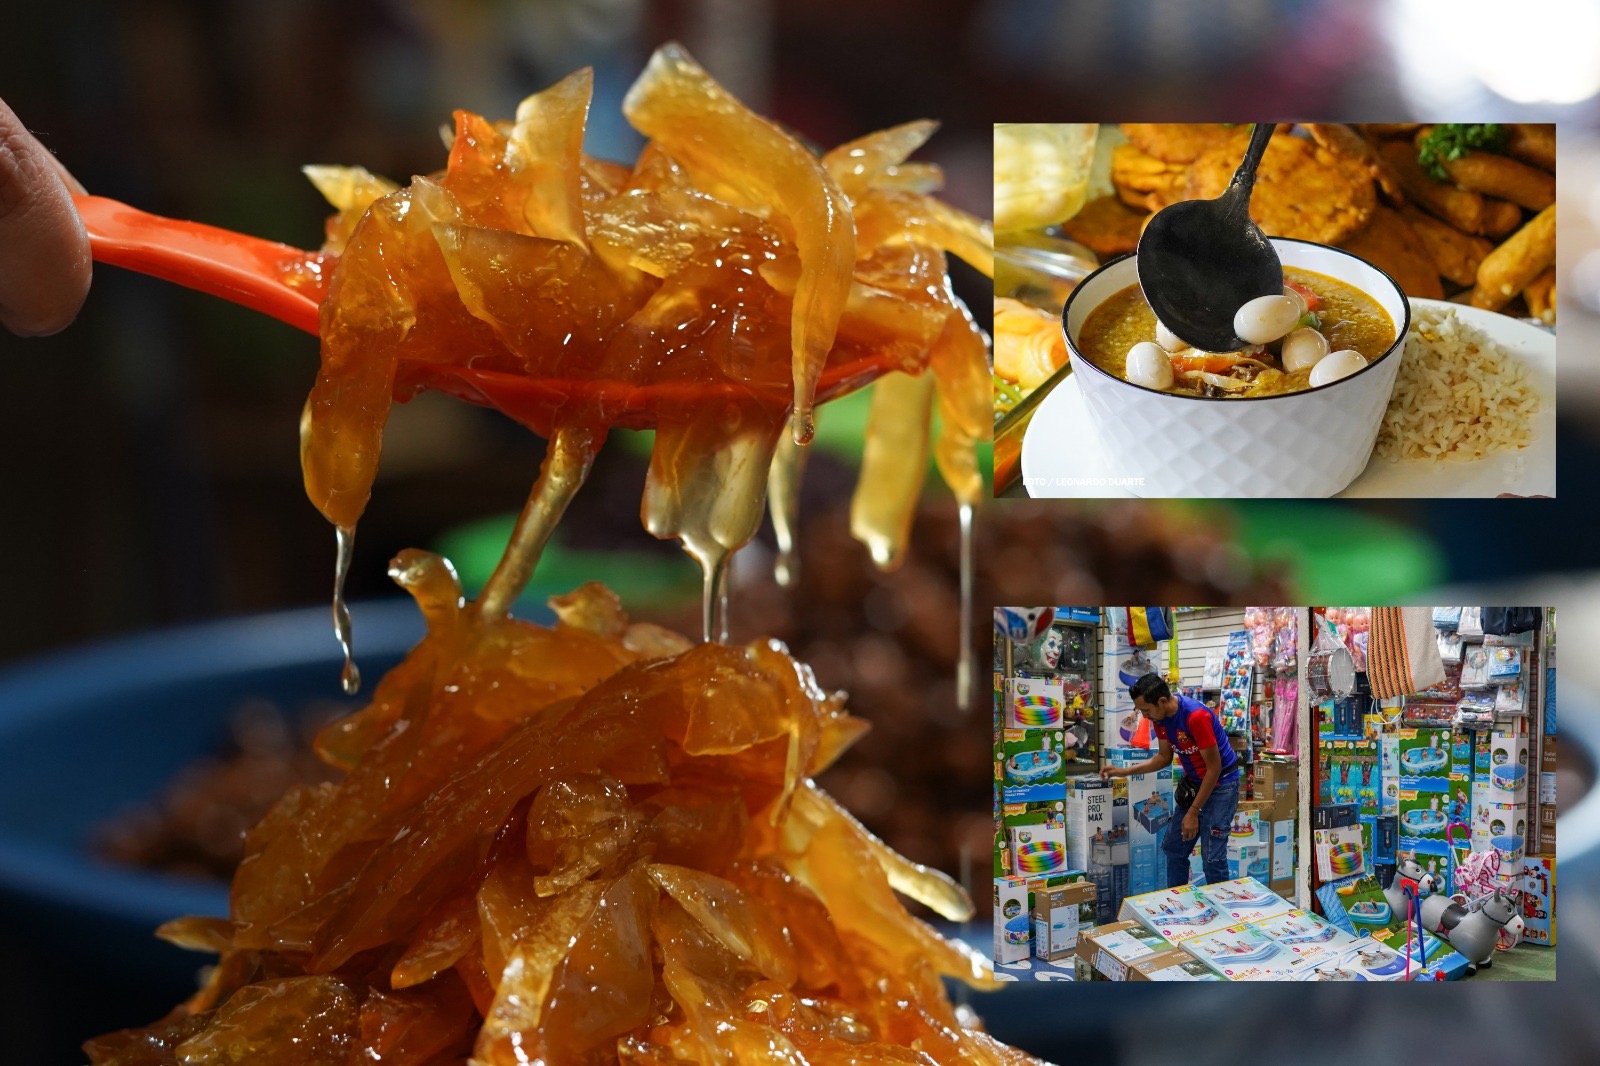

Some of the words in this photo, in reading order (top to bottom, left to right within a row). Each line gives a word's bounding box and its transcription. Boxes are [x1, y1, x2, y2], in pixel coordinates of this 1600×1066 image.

[1087, 795, 1107, 805] STEEL
[1087, 804, 1101, 813] PRO
[1088, 813, 1103, 822] MAX
